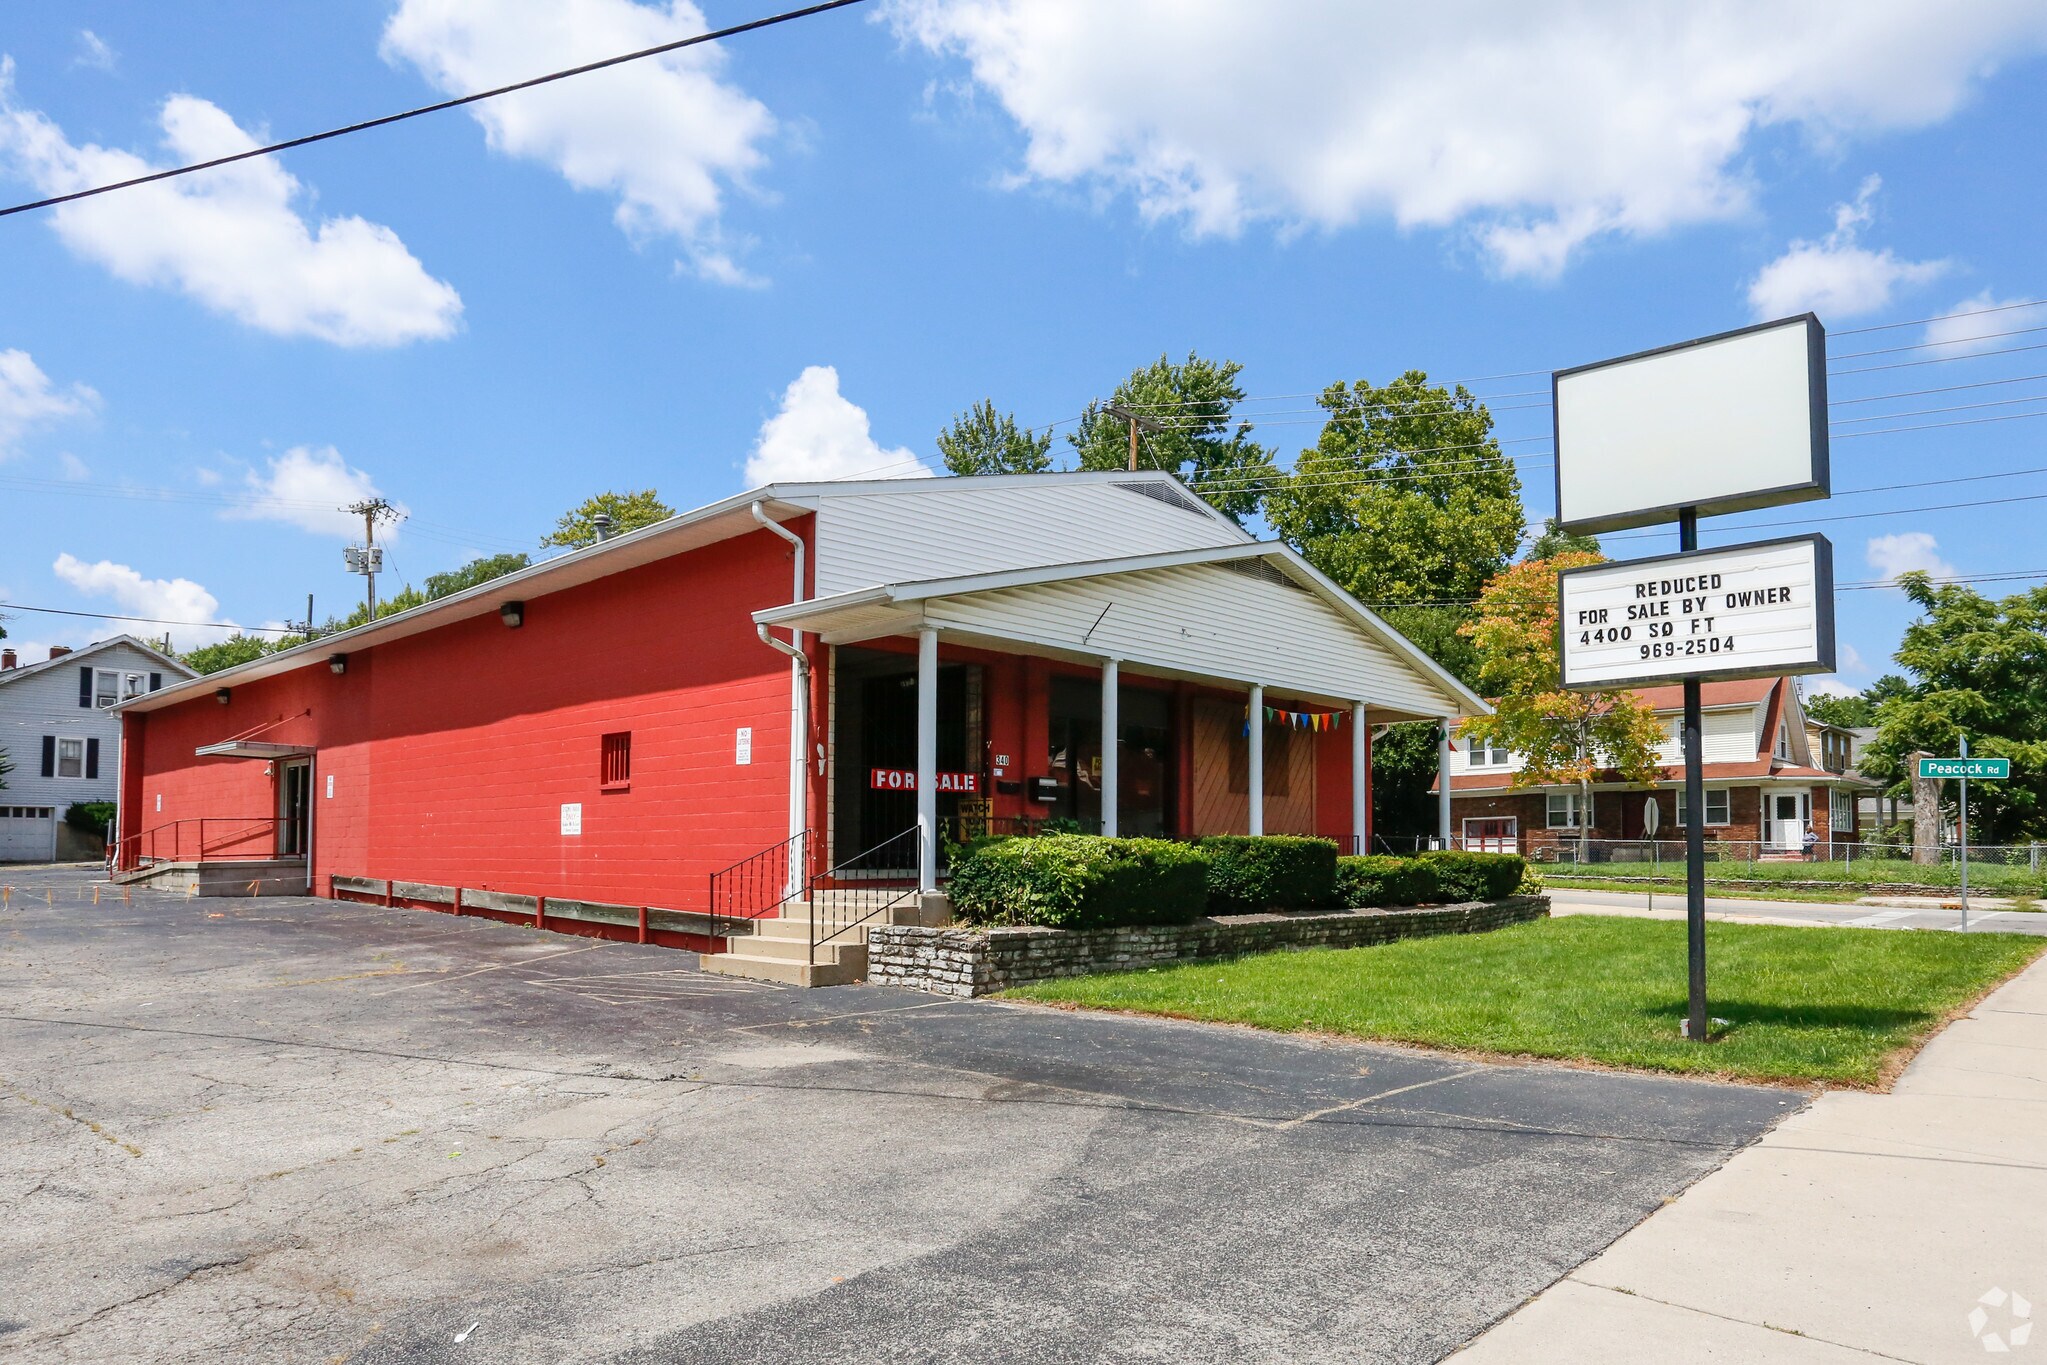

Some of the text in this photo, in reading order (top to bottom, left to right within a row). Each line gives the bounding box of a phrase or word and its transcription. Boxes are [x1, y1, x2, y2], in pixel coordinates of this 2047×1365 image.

[1636, 574, 1721, 598] REDUCED
[1579, 587, 1791, 625] FOR SALE BY OWNER
[1580, 626, 1632, 645] 4400
[1691, 617, 1715, 634] FT
[1640, 636, 1735, 659] 969-2504
[996, 755, 1009, 765] 340
[1928, 763, 1999, 774] Peacock Rd
[876, 770, 915, 788] FOR
[960, 803, 990, 813] WATCH
